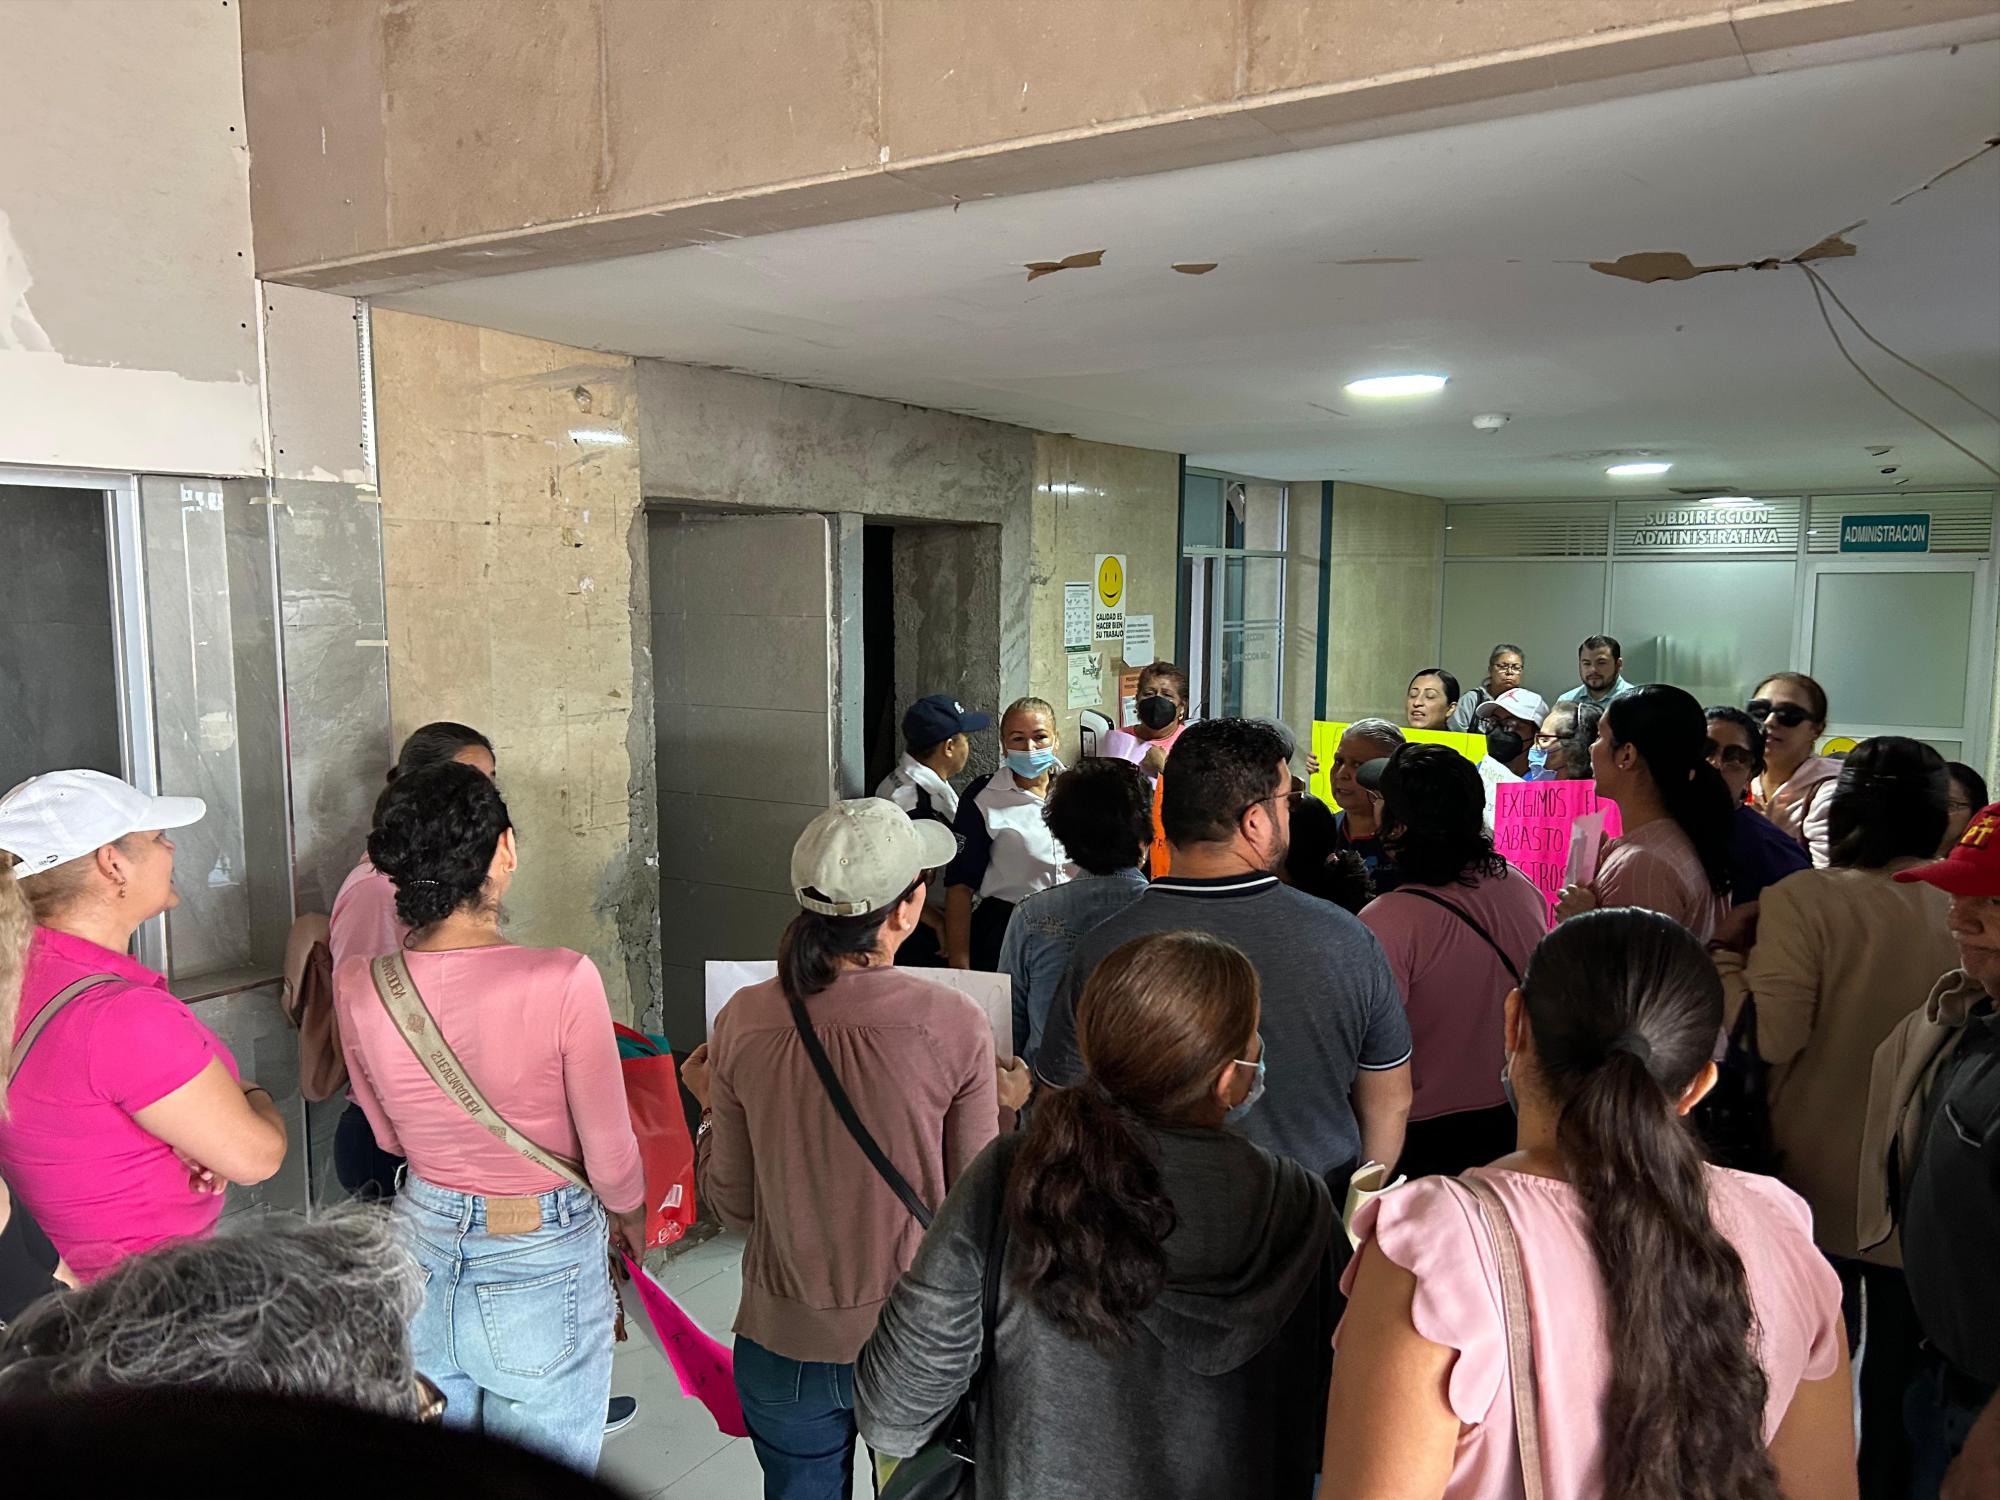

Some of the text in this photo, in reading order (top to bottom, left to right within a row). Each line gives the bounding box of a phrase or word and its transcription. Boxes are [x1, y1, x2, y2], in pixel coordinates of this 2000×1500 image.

[1645, 509, 1769, 526] SUBDIRECCION
[1633, 528, 1779, 545] ADMINISTRATIVA
[1843, 524, 1926, 543] ADMINISTRACION
[1096, 612, 1123, 621] CALIDAD ES
[1096, 621, 1111, 629] HACER
[1112, 621, 1123, 629] BIEN
[1096, 631, 1102, 639] SU
[1103, 629, 1124, 638] TRABAJO
[1502, 787, 1567, 818] EXIGIMOS
[1500, 824, 1564, 852] ABASTO
